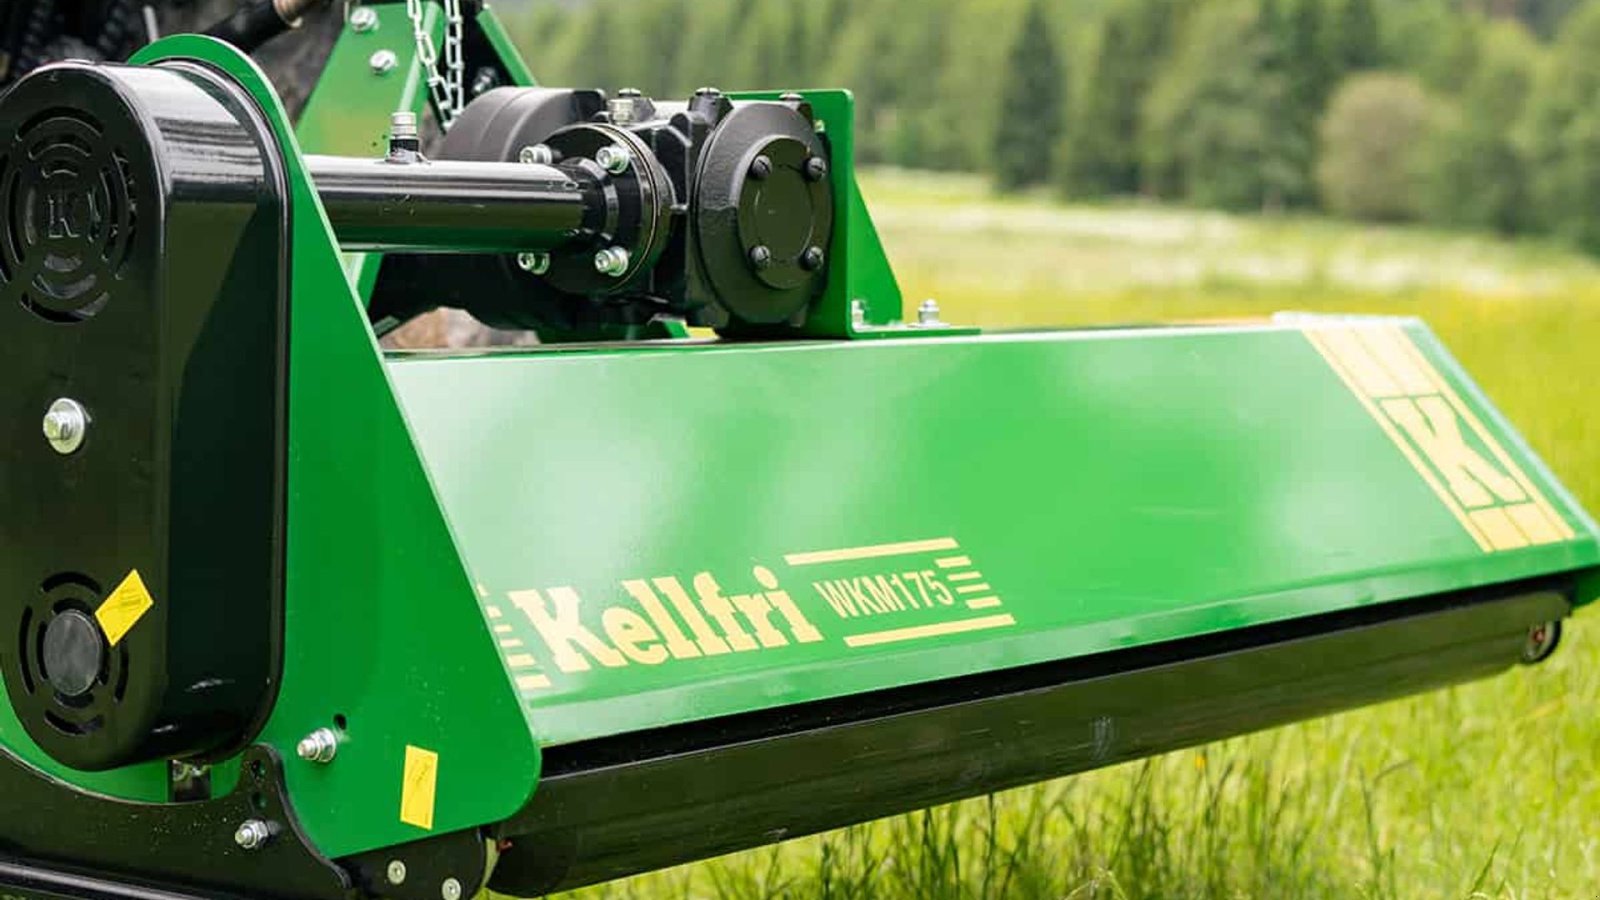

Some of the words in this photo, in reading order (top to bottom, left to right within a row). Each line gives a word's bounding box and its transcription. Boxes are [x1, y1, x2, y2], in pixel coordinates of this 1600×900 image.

[47, 192, 81, 238] K
[1378, 397, 1529, 508] K
[507, 565, 824, 672] Kellfri
[812, 570, 954, 619] WKM175
